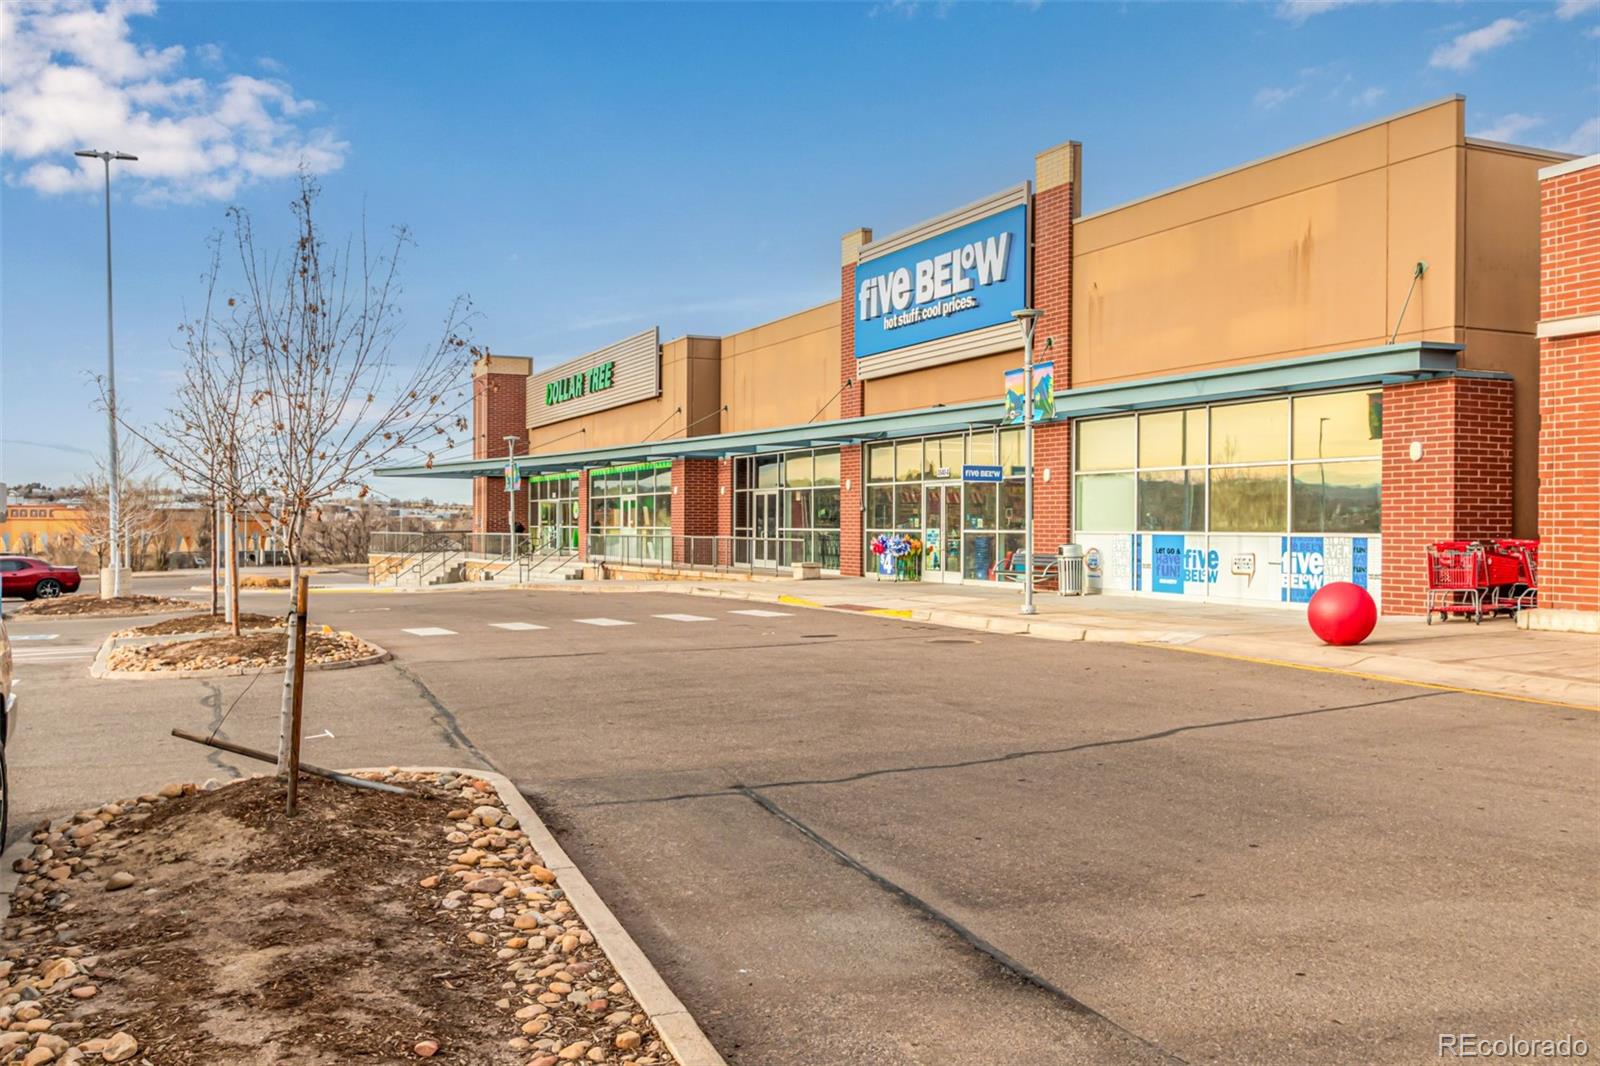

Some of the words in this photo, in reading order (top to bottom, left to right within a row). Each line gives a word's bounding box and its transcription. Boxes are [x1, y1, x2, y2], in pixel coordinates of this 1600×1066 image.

[858, 267, 914, 321] five
[915, 232, 1013, 305] BELOW
[883, 315, 898, 330] hot
[922, 299, 942, 319] cool
[546, 373, 585, 406] DOLLAR
[585, 360, 615, 393] TREE
[1184, 549, 1219, 569] five
[1282, 551, 1324, 575] five
[1184, 569, 1219, 583] BELOW
